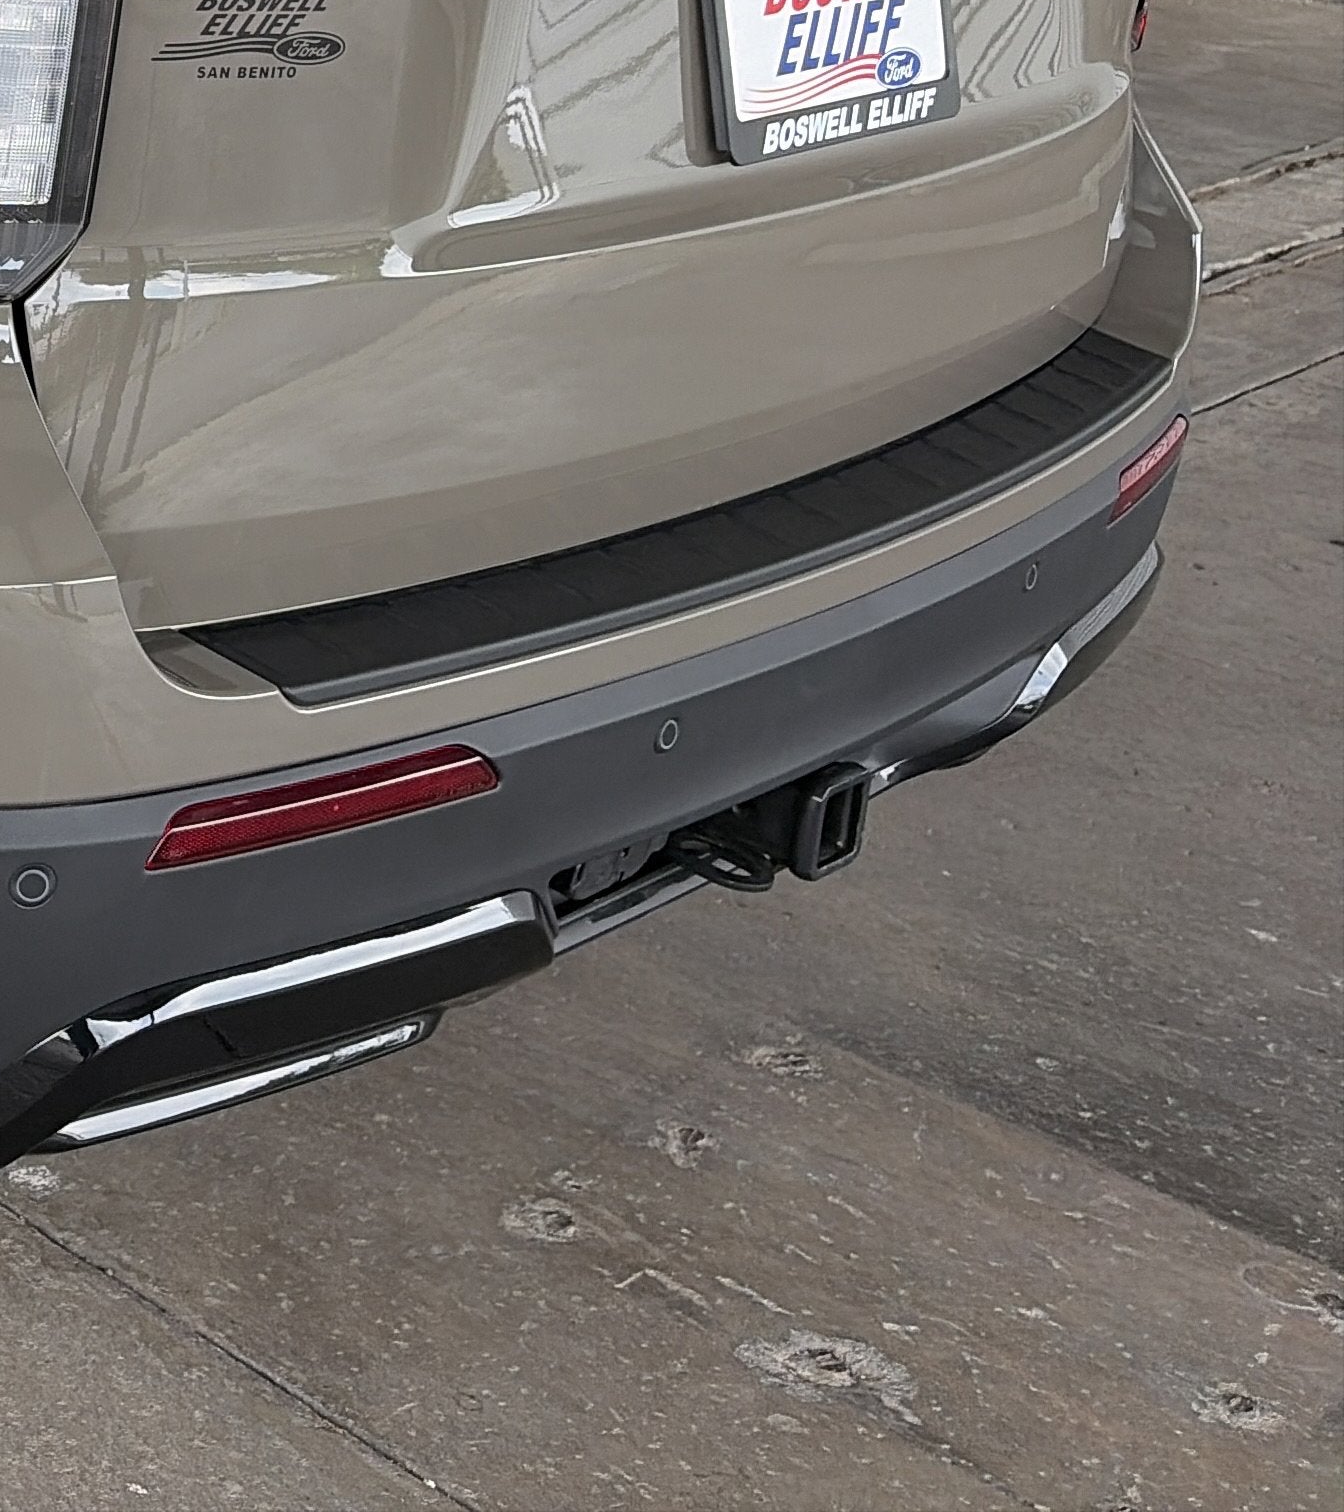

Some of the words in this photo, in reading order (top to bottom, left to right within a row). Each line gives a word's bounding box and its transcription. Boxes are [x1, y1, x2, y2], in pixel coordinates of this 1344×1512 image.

[200, 14, 306, 36] ELLIFF
[287, 39, 330, 58] Ford
[197, 66, 231, 79] SAN
[237, 66, 297, 79] BENITO
[884, 54, 914, 83] Ford
[762, 103, 863, 155] BOSWELL
[867, 87, 937, 130] ELLIFF
